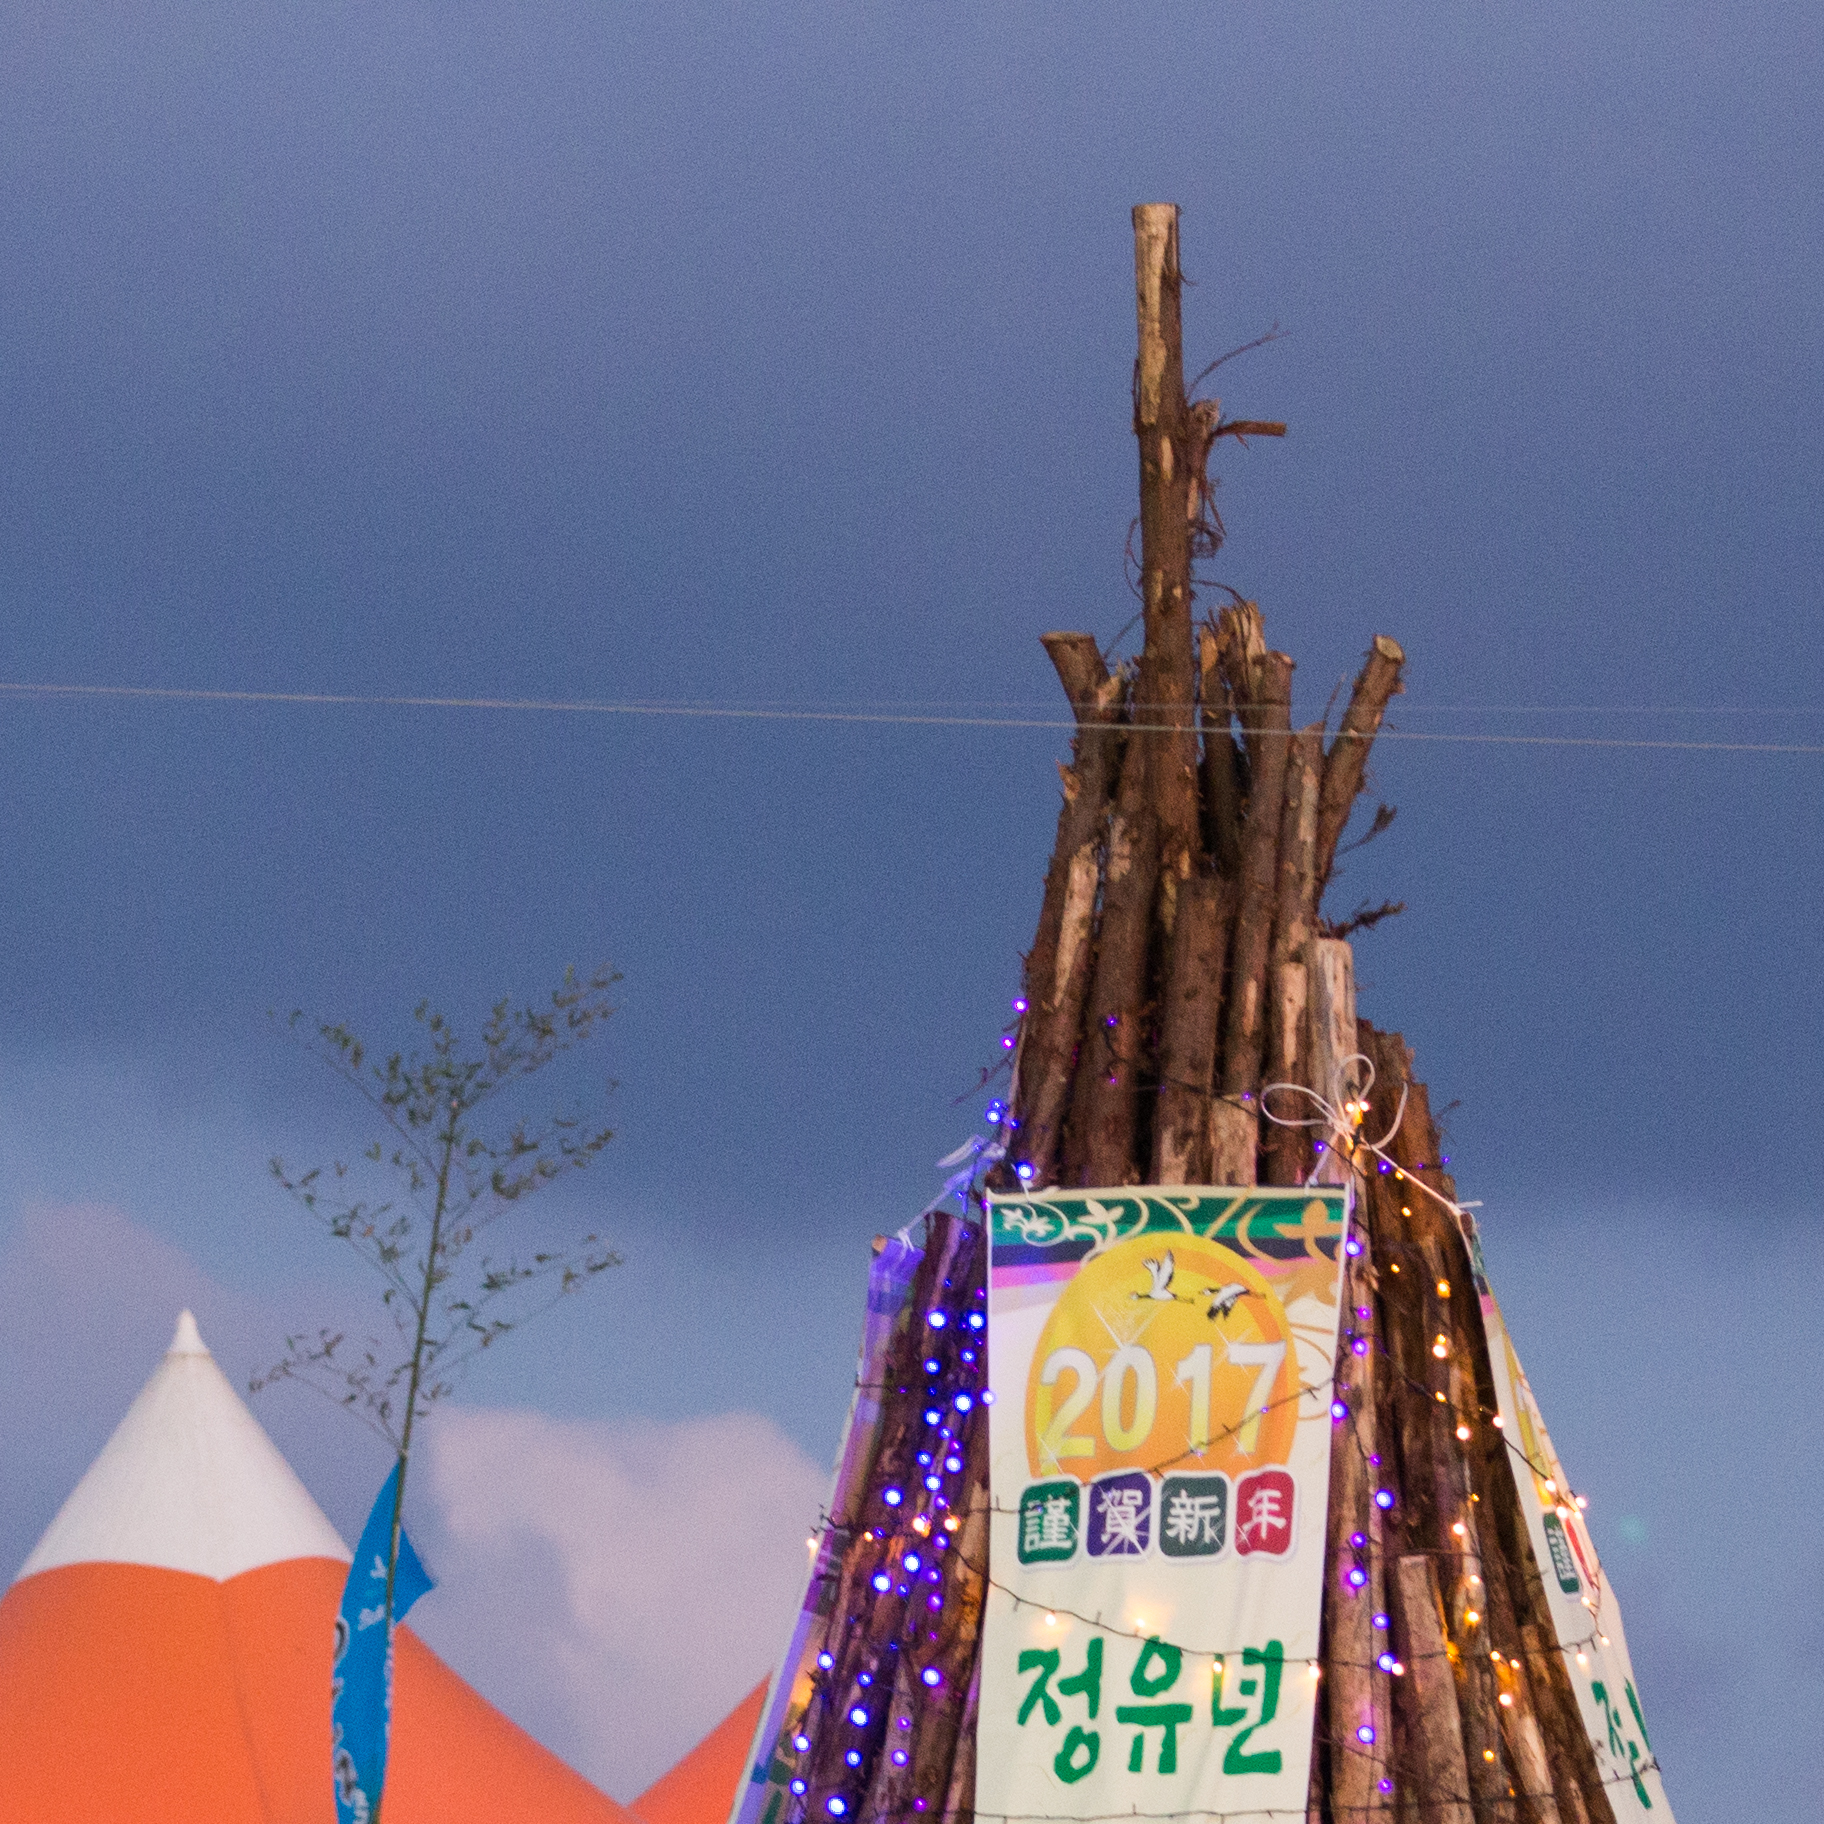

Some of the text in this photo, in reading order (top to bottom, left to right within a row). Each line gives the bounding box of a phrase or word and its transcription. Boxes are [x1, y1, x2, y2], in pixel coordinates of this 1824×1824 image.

[1039, 1341, 1287, 1462] 2017
[1023, 1486, 1285, 1555] 謹賀新年
[1017, 1636, 1284, 1784] 정유년
